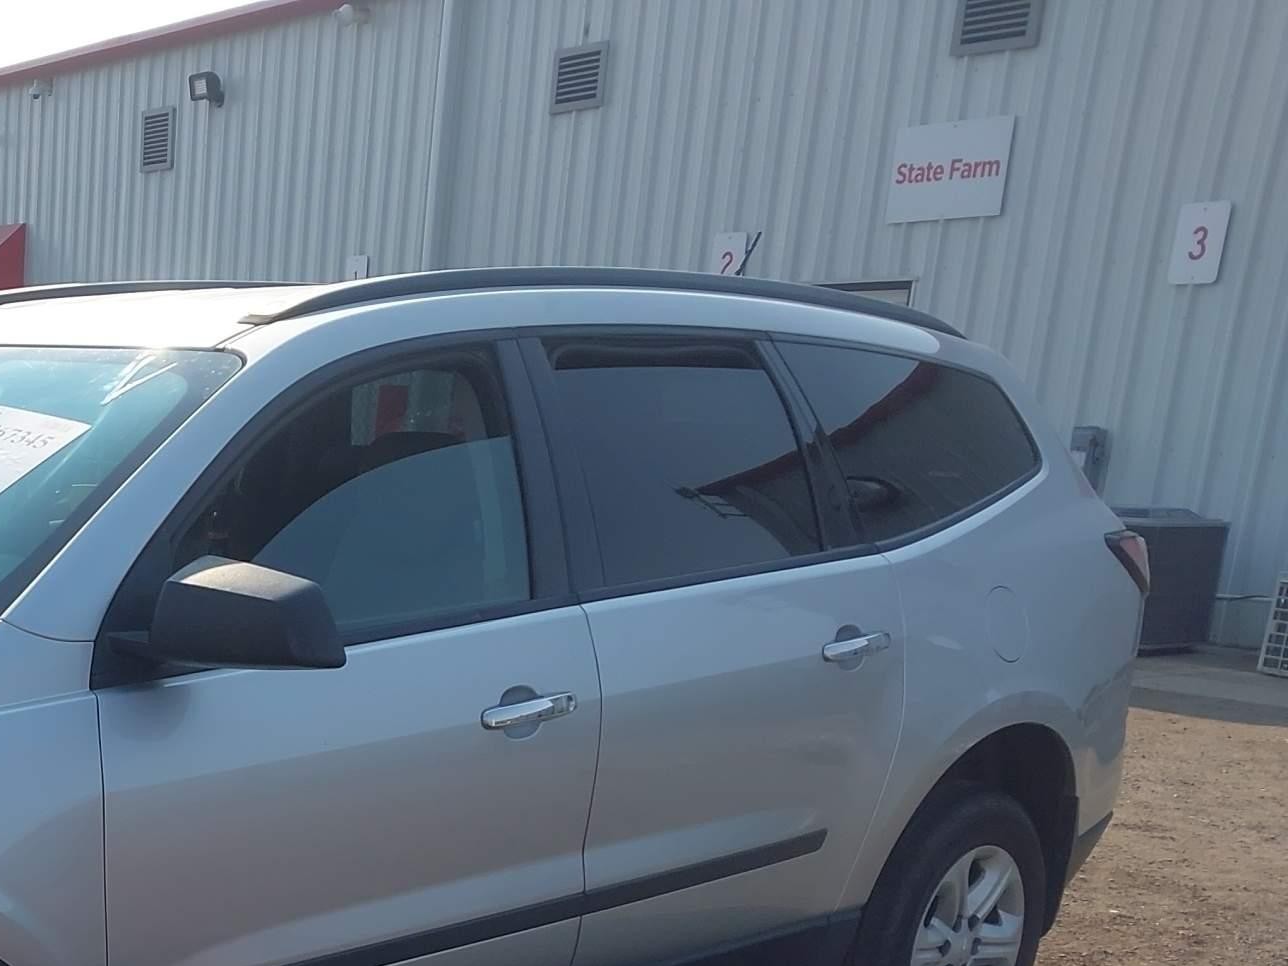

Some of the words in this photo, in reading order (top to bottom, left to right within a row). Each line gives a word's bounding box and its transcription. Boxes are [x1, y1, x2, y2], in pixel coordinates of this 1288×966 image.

[895, 162, 945, 184] State
[948, 158, 1001, 180] Farm
[1188, 226, 1209, 261] 3
[720, 251, 734, 275] 2
